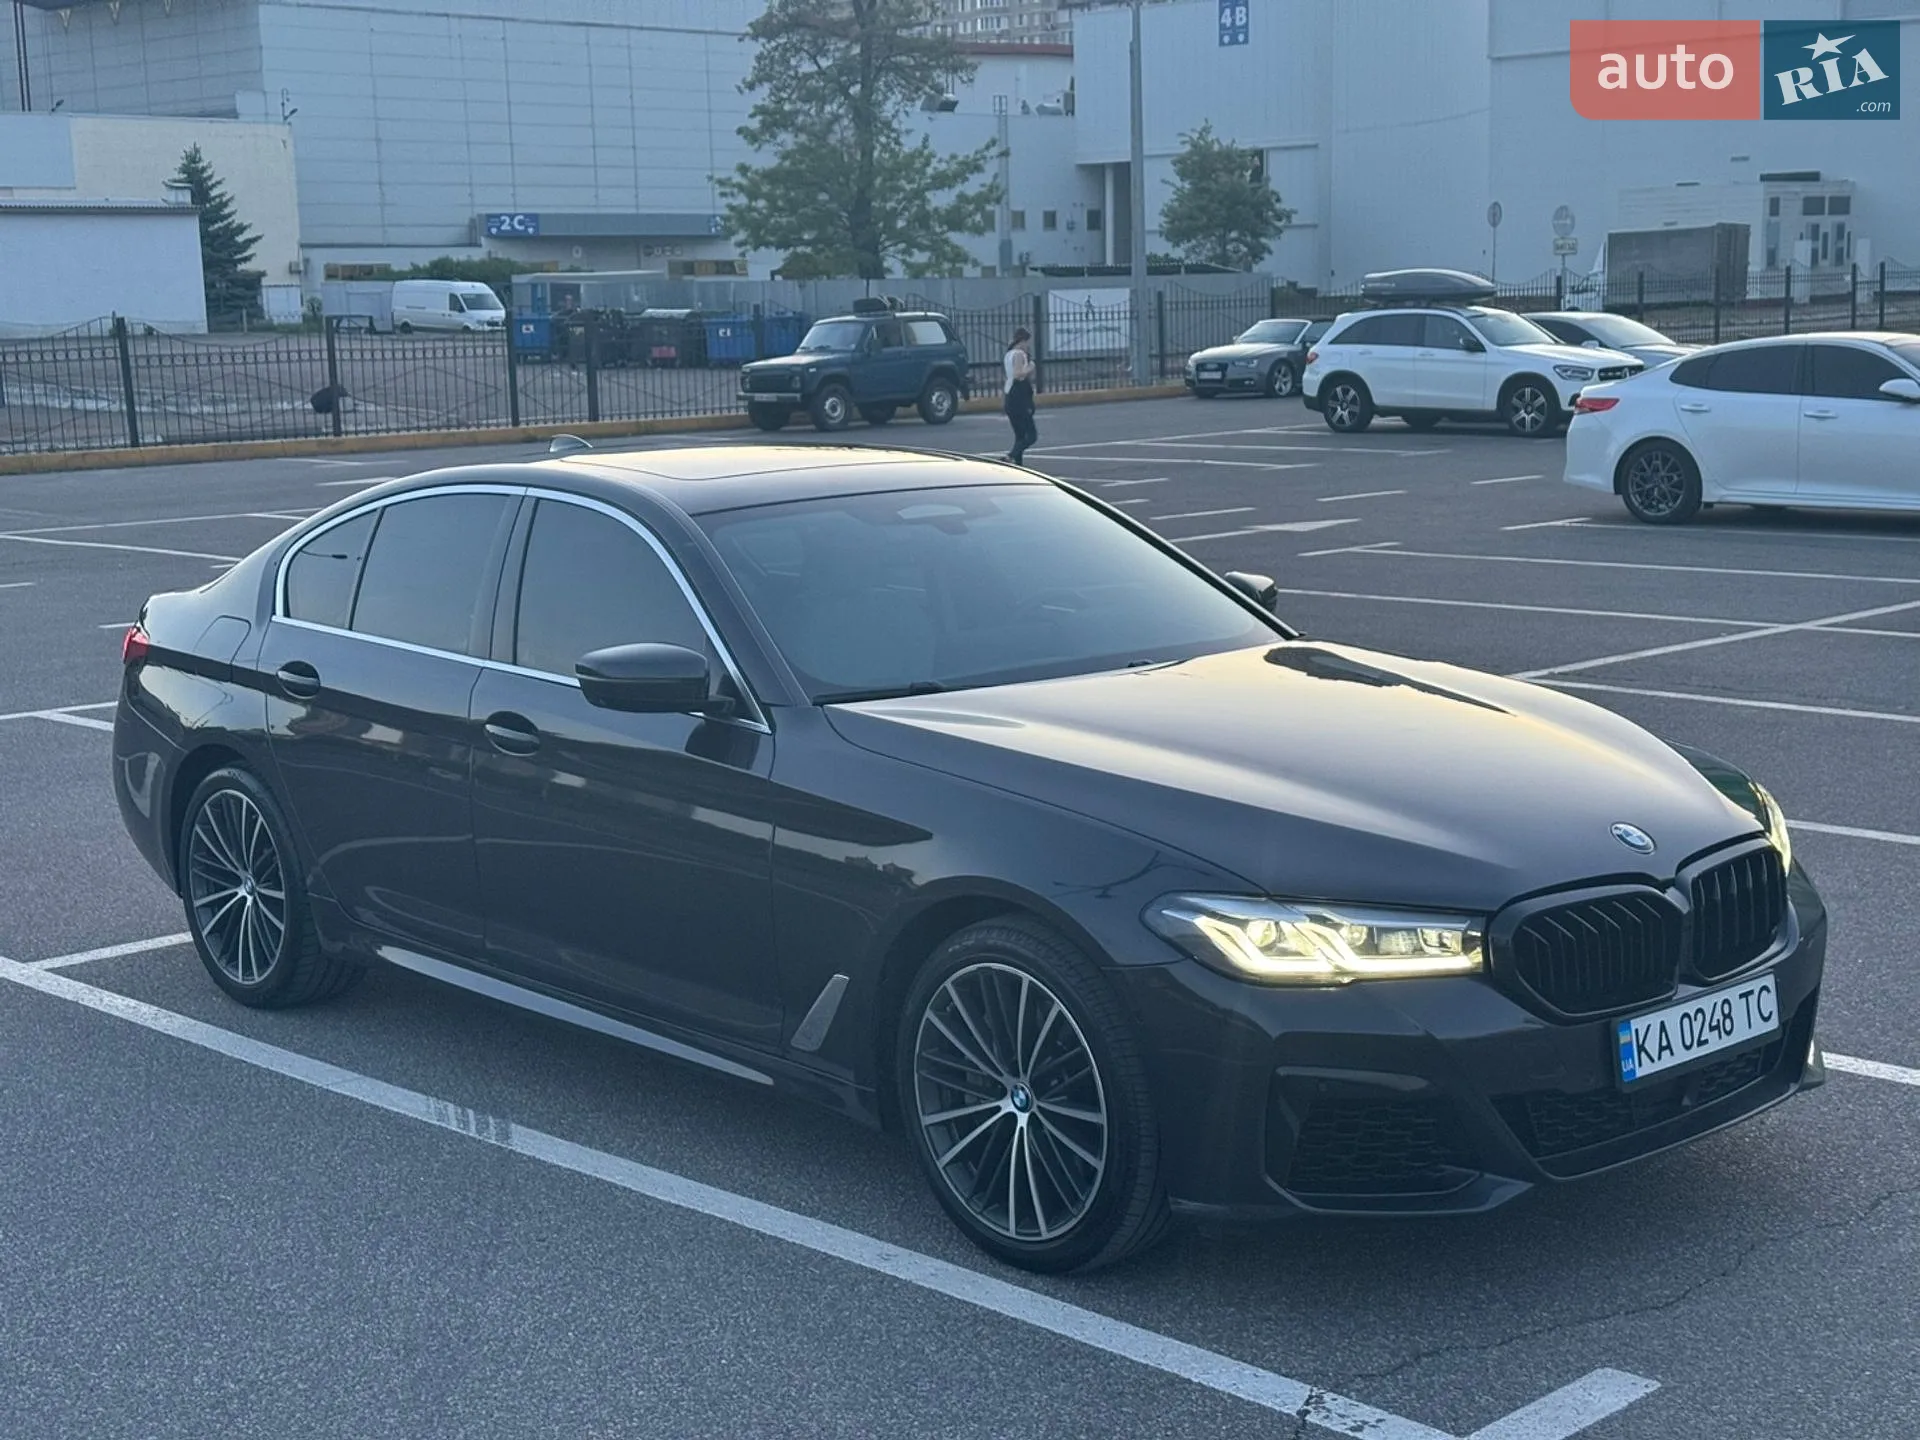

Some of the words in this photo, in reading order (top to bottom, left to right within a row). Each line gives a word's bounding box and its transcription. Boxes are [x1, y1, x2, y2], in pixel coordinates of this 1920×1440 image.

[1635, 1020, 1674, 1068] KA
[1679, 998, 1735, 1051] 0248
[1738, 984, 1774, 1030] TC
